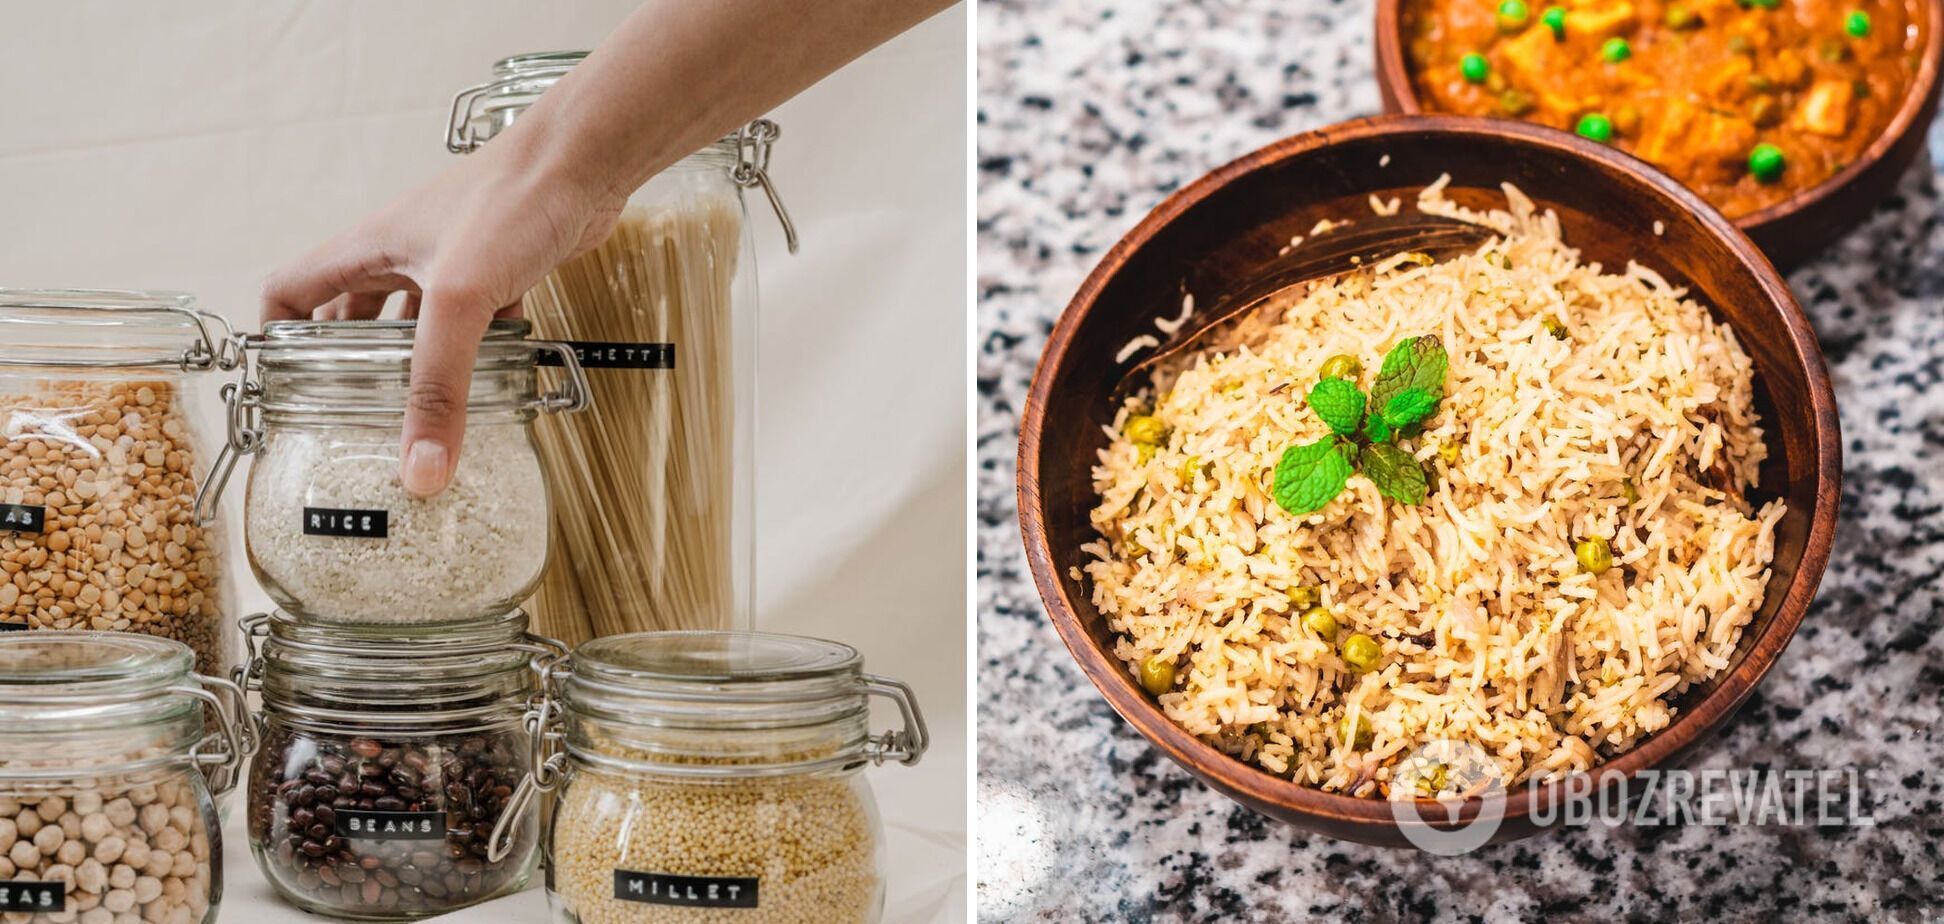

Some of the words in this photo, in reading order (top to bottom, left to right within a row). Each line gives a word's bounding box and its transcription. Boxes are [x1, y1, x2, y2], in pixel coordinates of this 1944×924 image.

[546, 348, 665, 361] GHETTI
[4, 511, 33, 525] AS
[311, 513, 372, 531] RICE
[349, 817, 432, 833] BEANS
[0, 887, 53, 906] EAS
[628, 879, 741, 901] MILLET
